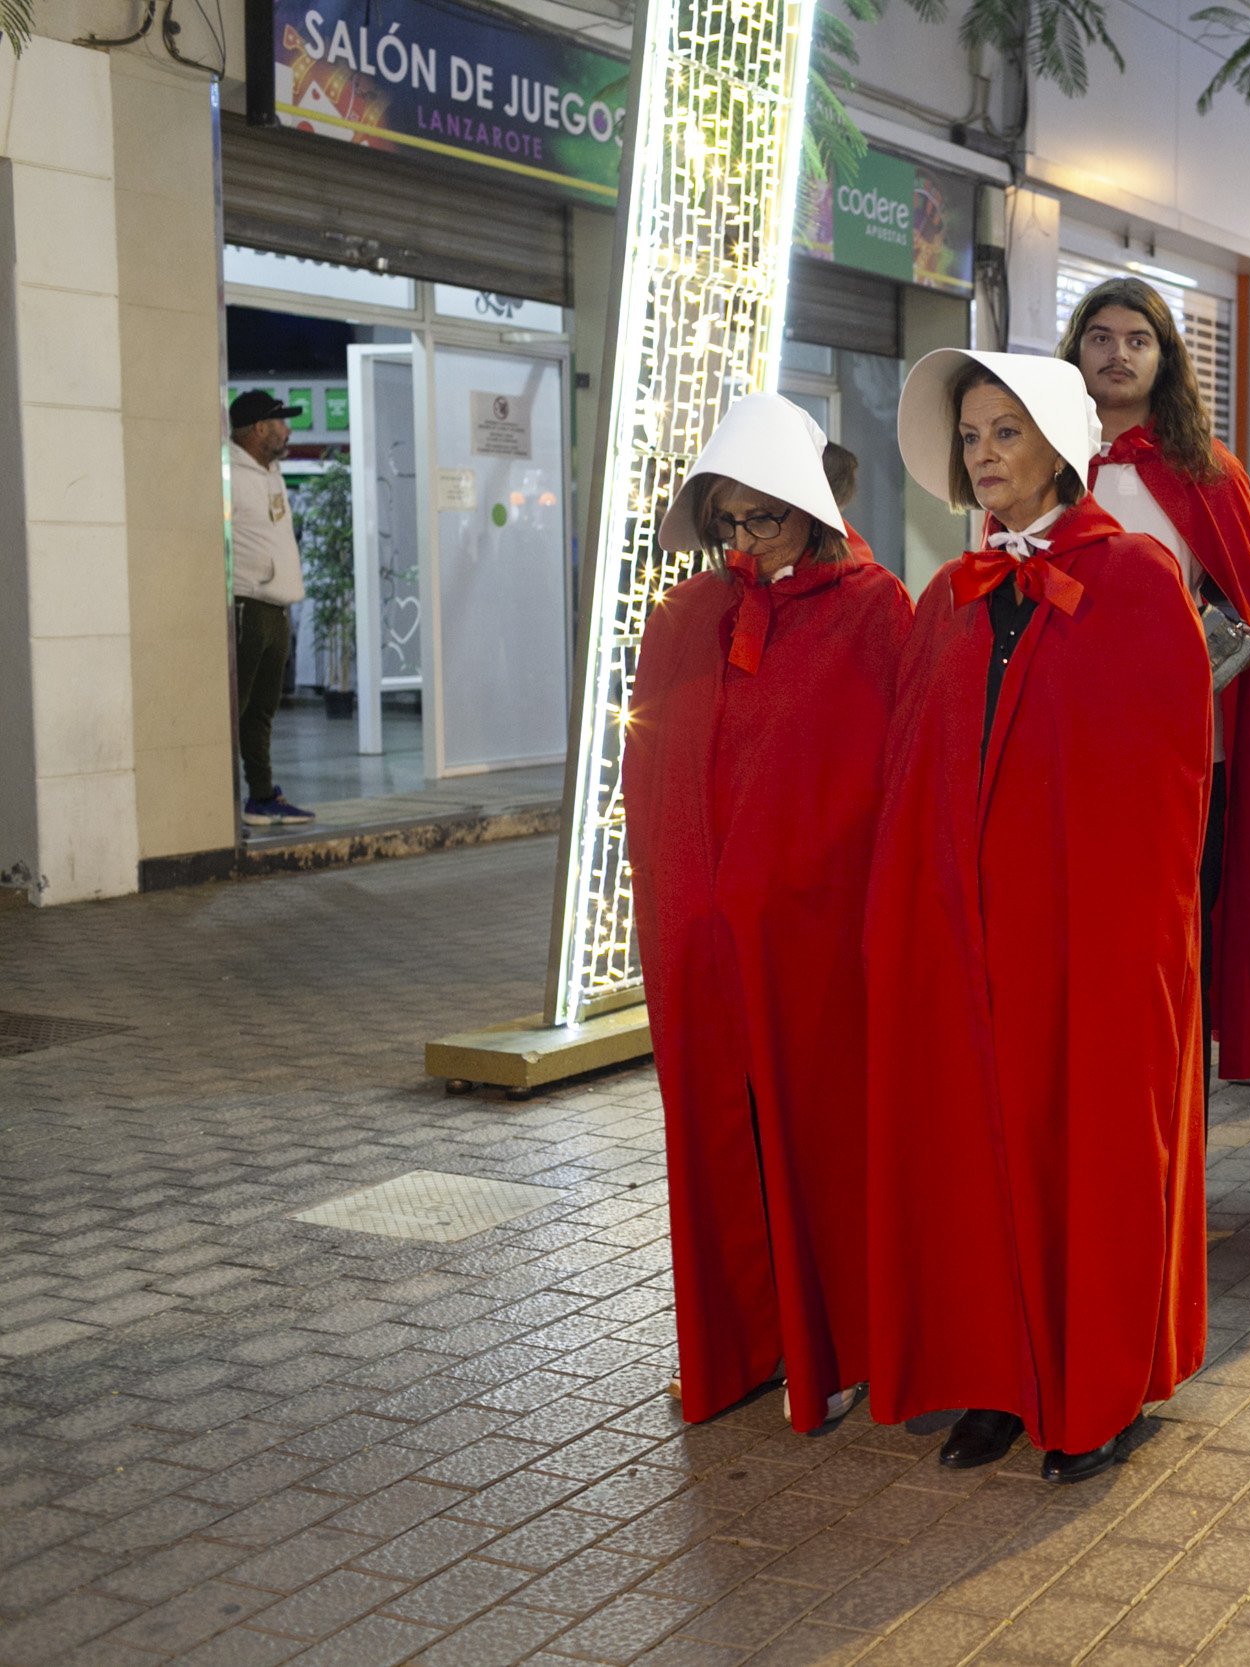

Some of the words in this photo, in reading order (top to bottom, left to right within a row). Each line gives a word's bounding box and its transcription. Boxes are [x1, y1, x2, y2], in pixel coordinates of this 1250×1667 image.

[304, 9, 437, 93] SALÓN
[450, 55, 494, 110] DE
[503, 74, 626, 148] JUEGOS
[417, 105, 542, 160] LANZAROTE
[838, 185, 909, 229] codere
